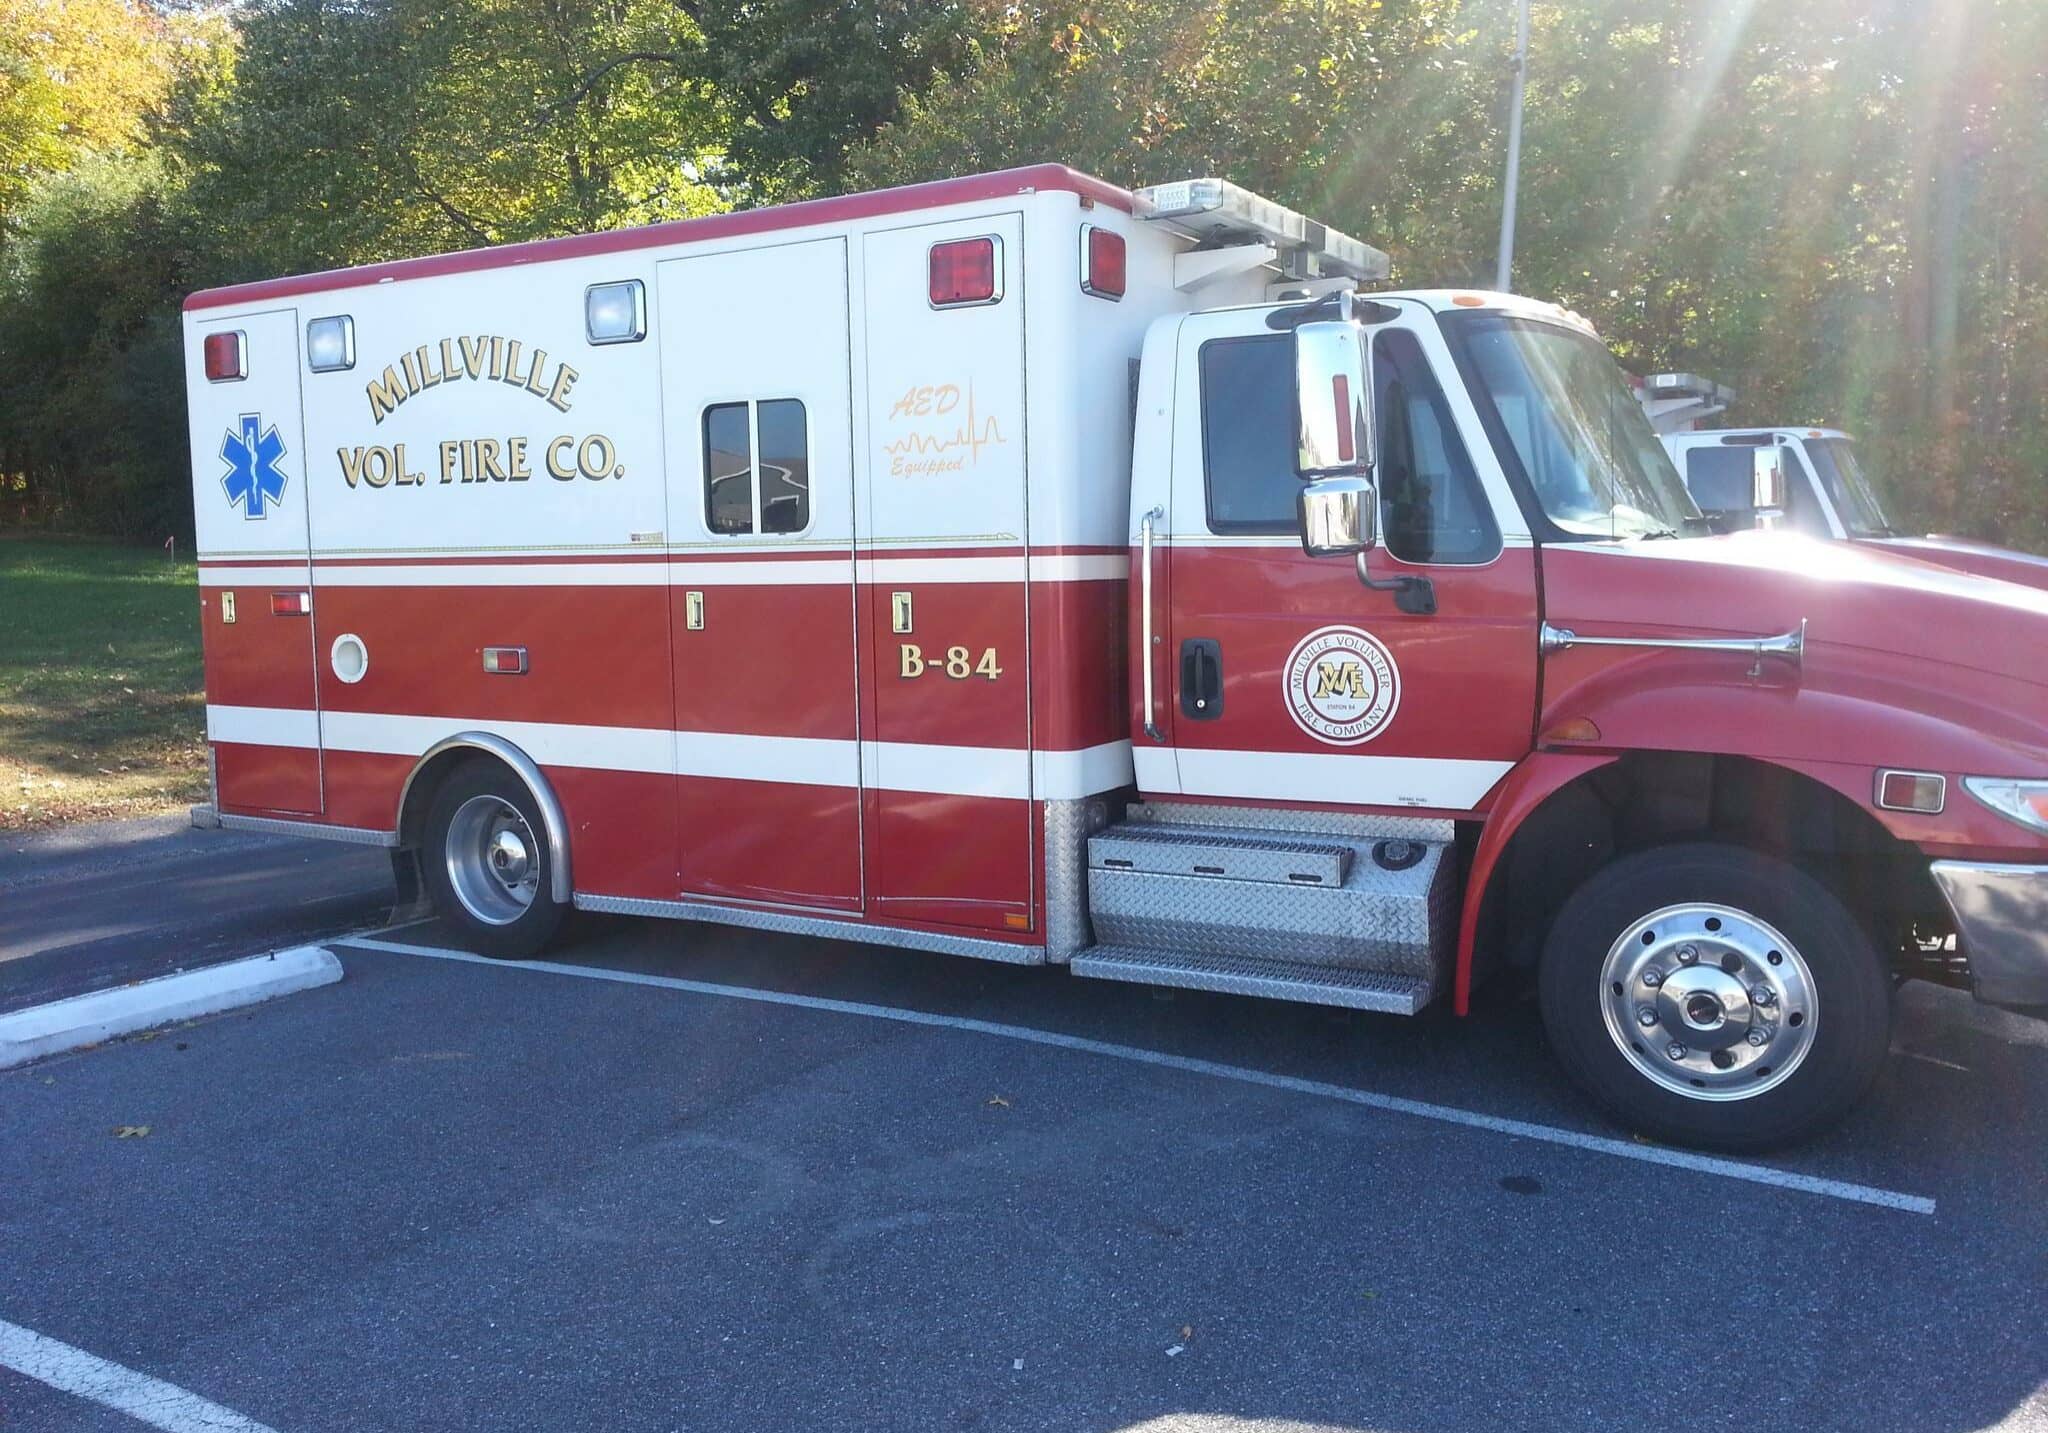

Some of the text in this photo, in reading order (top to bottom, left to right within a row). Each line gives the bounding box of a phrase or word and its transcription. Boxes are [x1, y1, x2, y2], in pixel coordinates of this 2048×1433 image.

[366, 335, 579, 425] MILLVILLE
[889, 383, 960, 421] AED
[337, 434, 625, 489] VOL. FIRE CO.
[891, 455, 964, 479] Equipped
[900, 643, 1003, 681] B-84
[1293, 635, 1391, 690] MILLVILLE VOLUNTEER
[1298, 703, 1385, 736] FIRE COMPANY
